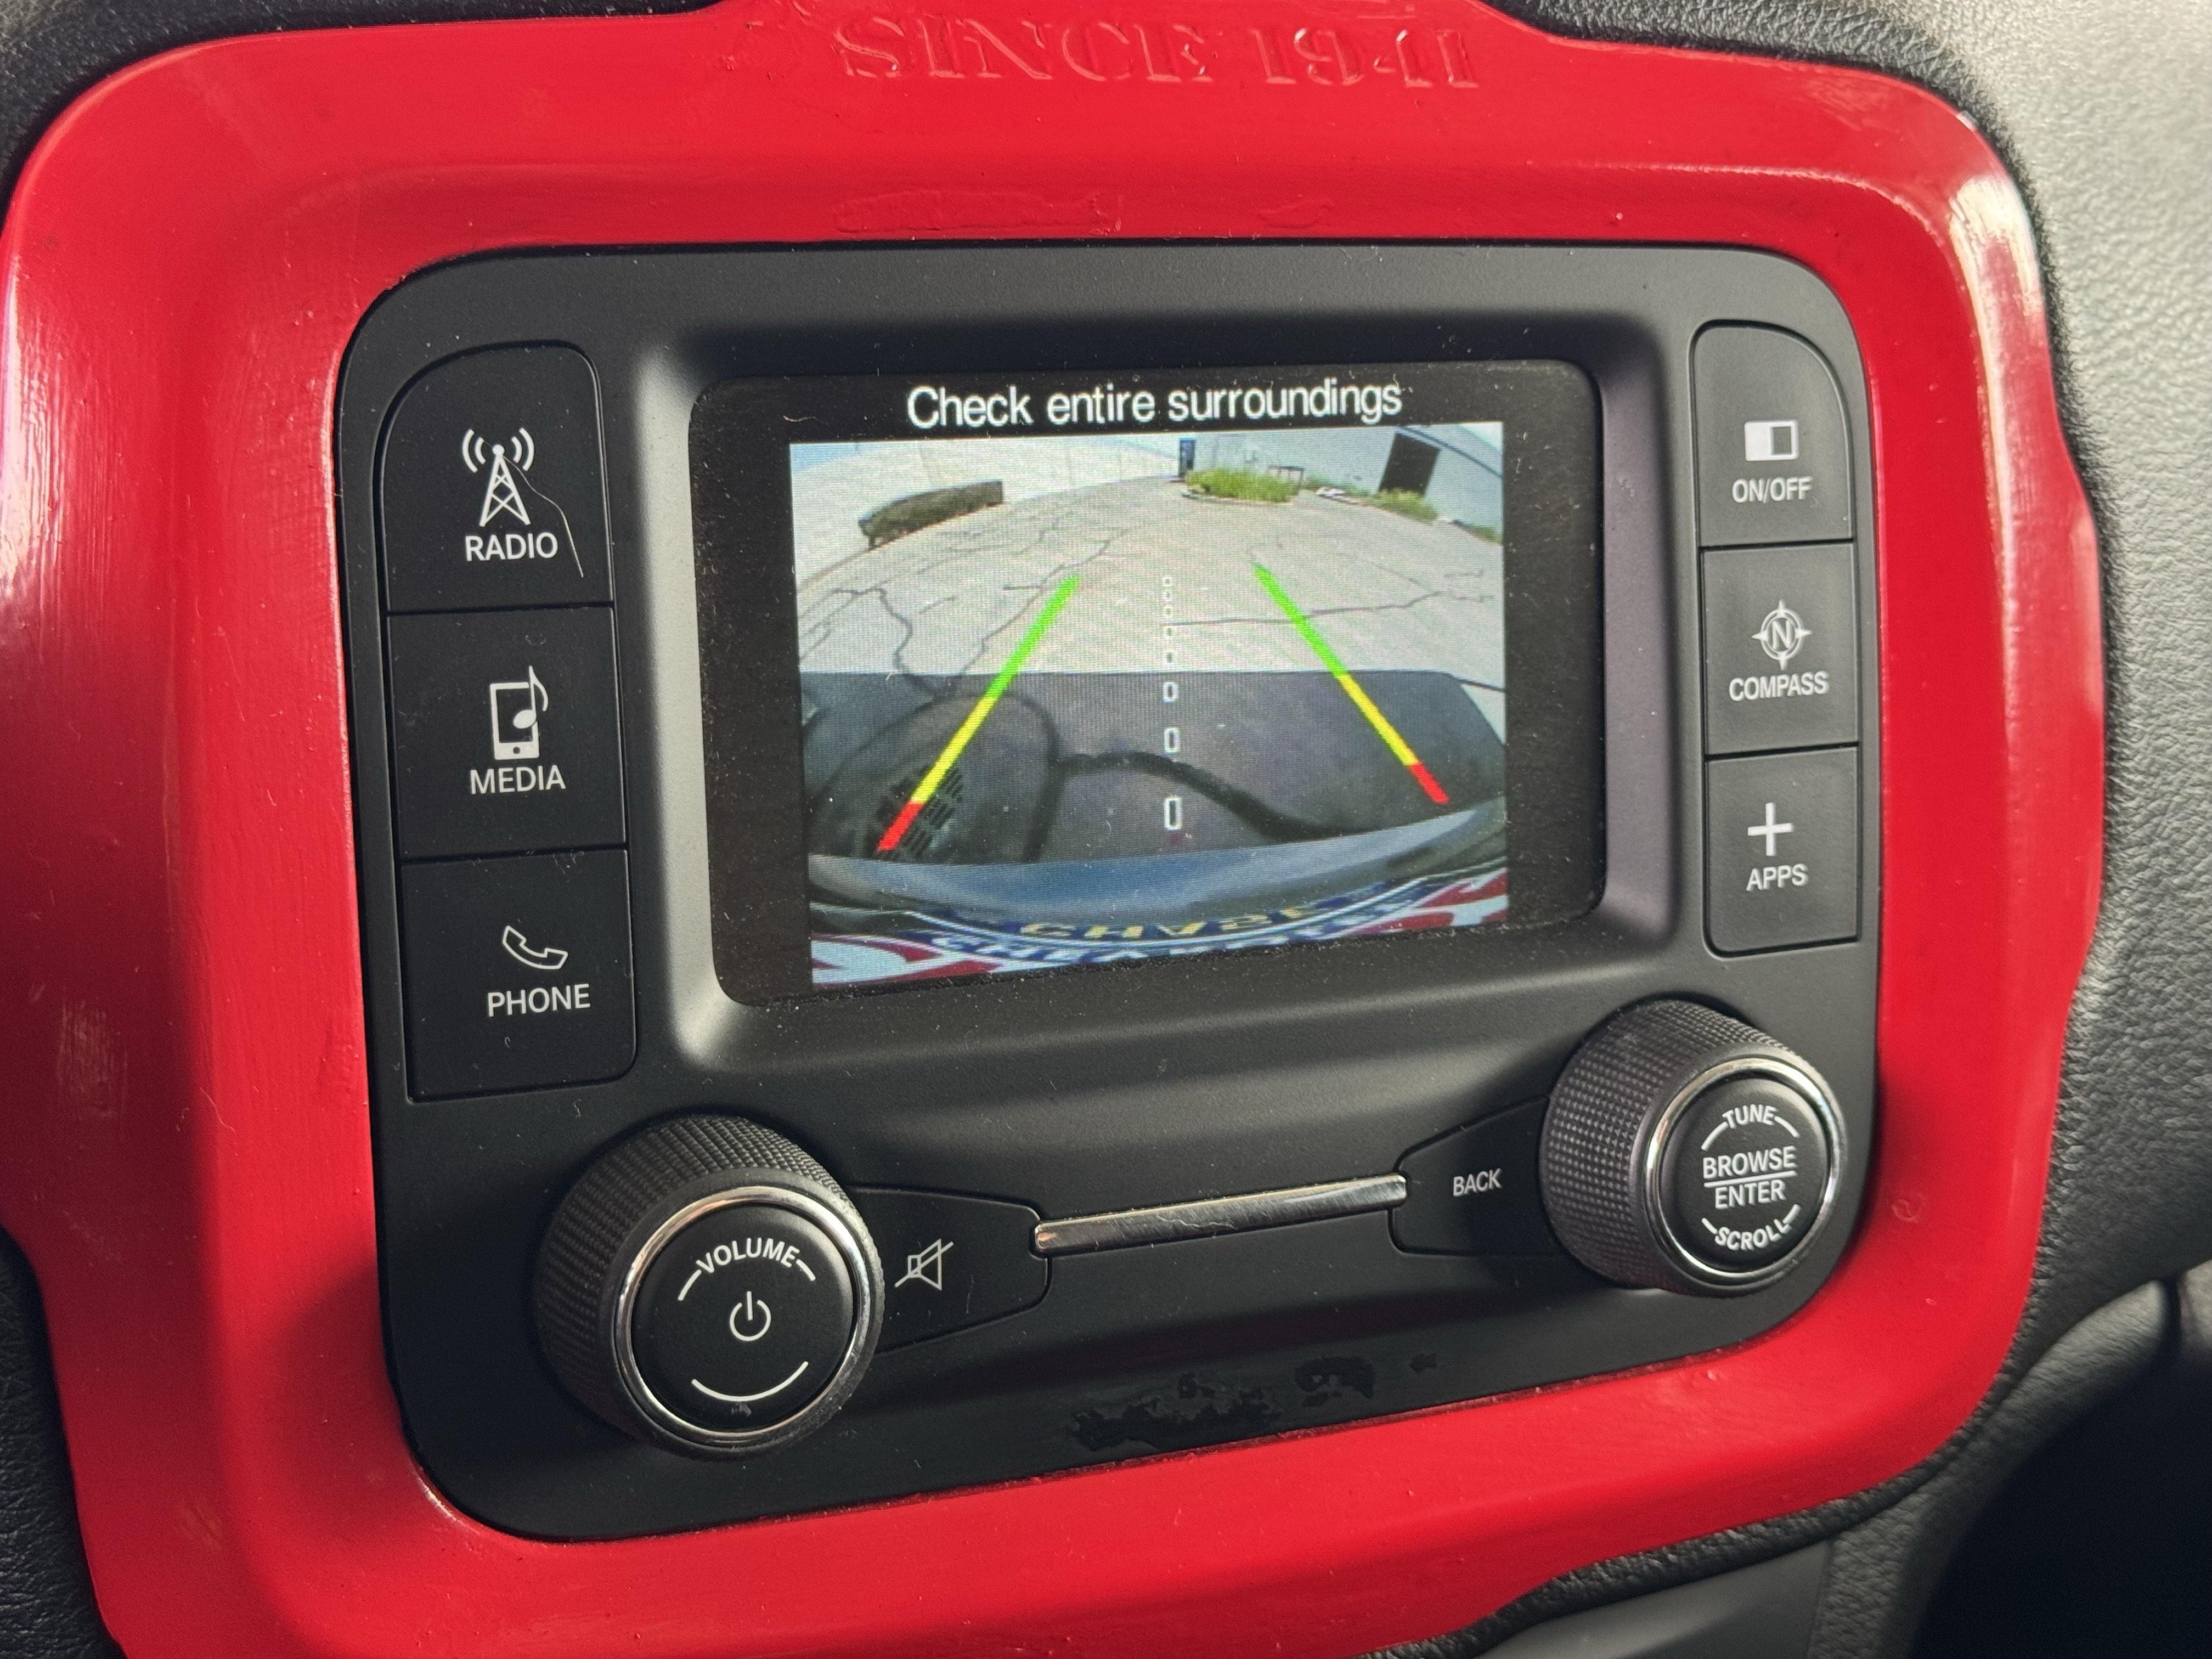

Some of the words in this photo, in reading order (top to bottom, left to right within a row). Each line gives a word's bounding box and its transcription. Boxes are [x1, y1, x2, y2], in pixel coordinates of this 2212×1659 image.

[834, 13, 1214, 82] SINCE
[1248, 27, 1480, 88] 1941
[907, 386, 1033, 429] Check
[1047, 386, 1156, 423] entire
[1169, 377, 1403, 425] surroundings
[1732, 476, 1812, 504] ON/OFF
[465, 532, 558, 562] RADIO
[1729, 670, 1830, 701] COMPASS
[470, 765, 566, 794] MEDIA
[1746, 863, 1809, 891] APPS
[488, 984, 591, 1017] PHONE
[1722, 1104, 1778, 1129] TUNE
[1703, 1146, 1798, 1180] BROWSE
[1453, 1167, 1503, 1197] BACK
[1715, 1180, 1787, 1209] ENTER
[1714, 1218, 1792, 1251] SCROLL
[696, 1237, 800, 1273] VOLUME
